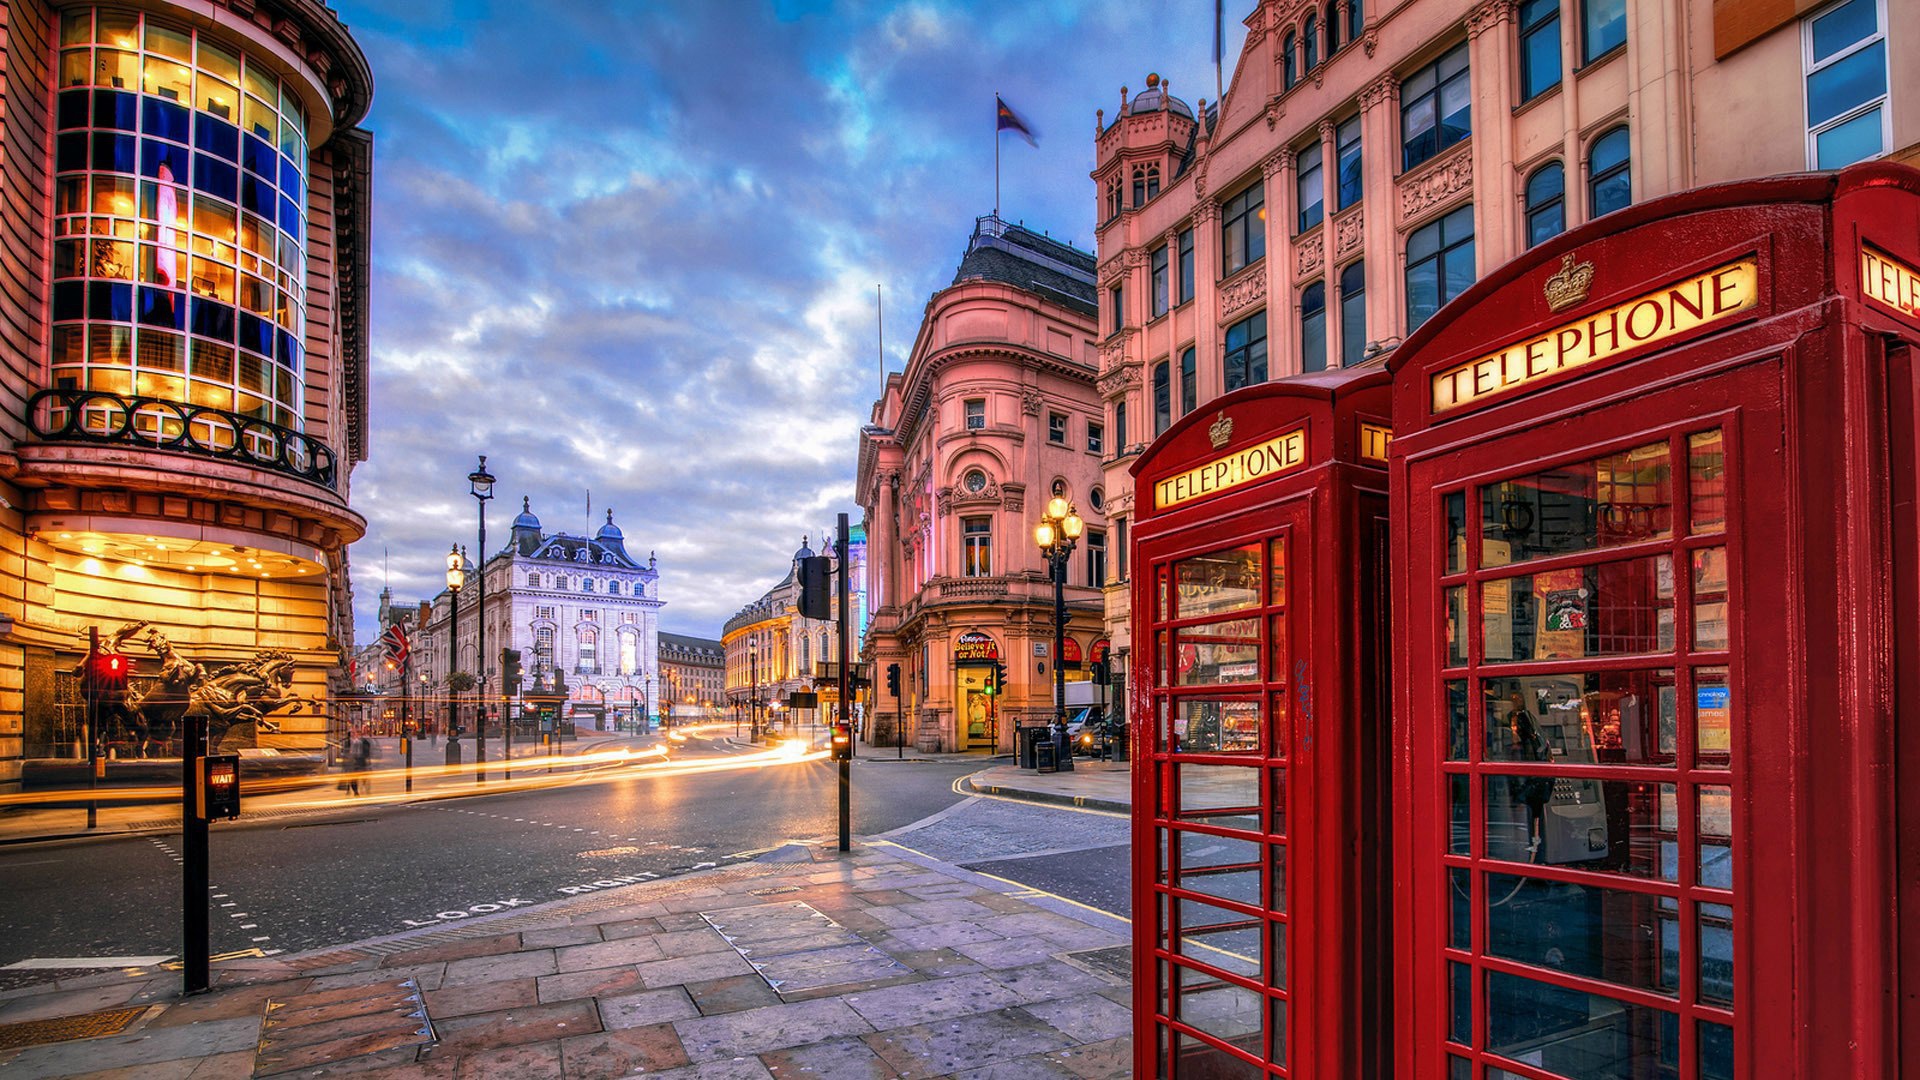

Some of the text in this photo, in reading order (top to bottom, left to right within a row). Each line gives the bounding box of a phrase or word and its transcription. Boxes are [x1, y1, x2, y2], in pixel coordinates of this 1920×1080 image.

[1441, 264, 1744, 405] TELEPHONE
[1159, 434, 1300, 505] TELEPHONE
[954, 641, 996, 652] Believe It
[958, 649, 990, 659] or Not!
[211, 774, 234, 785] WAIT
[402, 870, 660, 927] LOOK RIGHT
